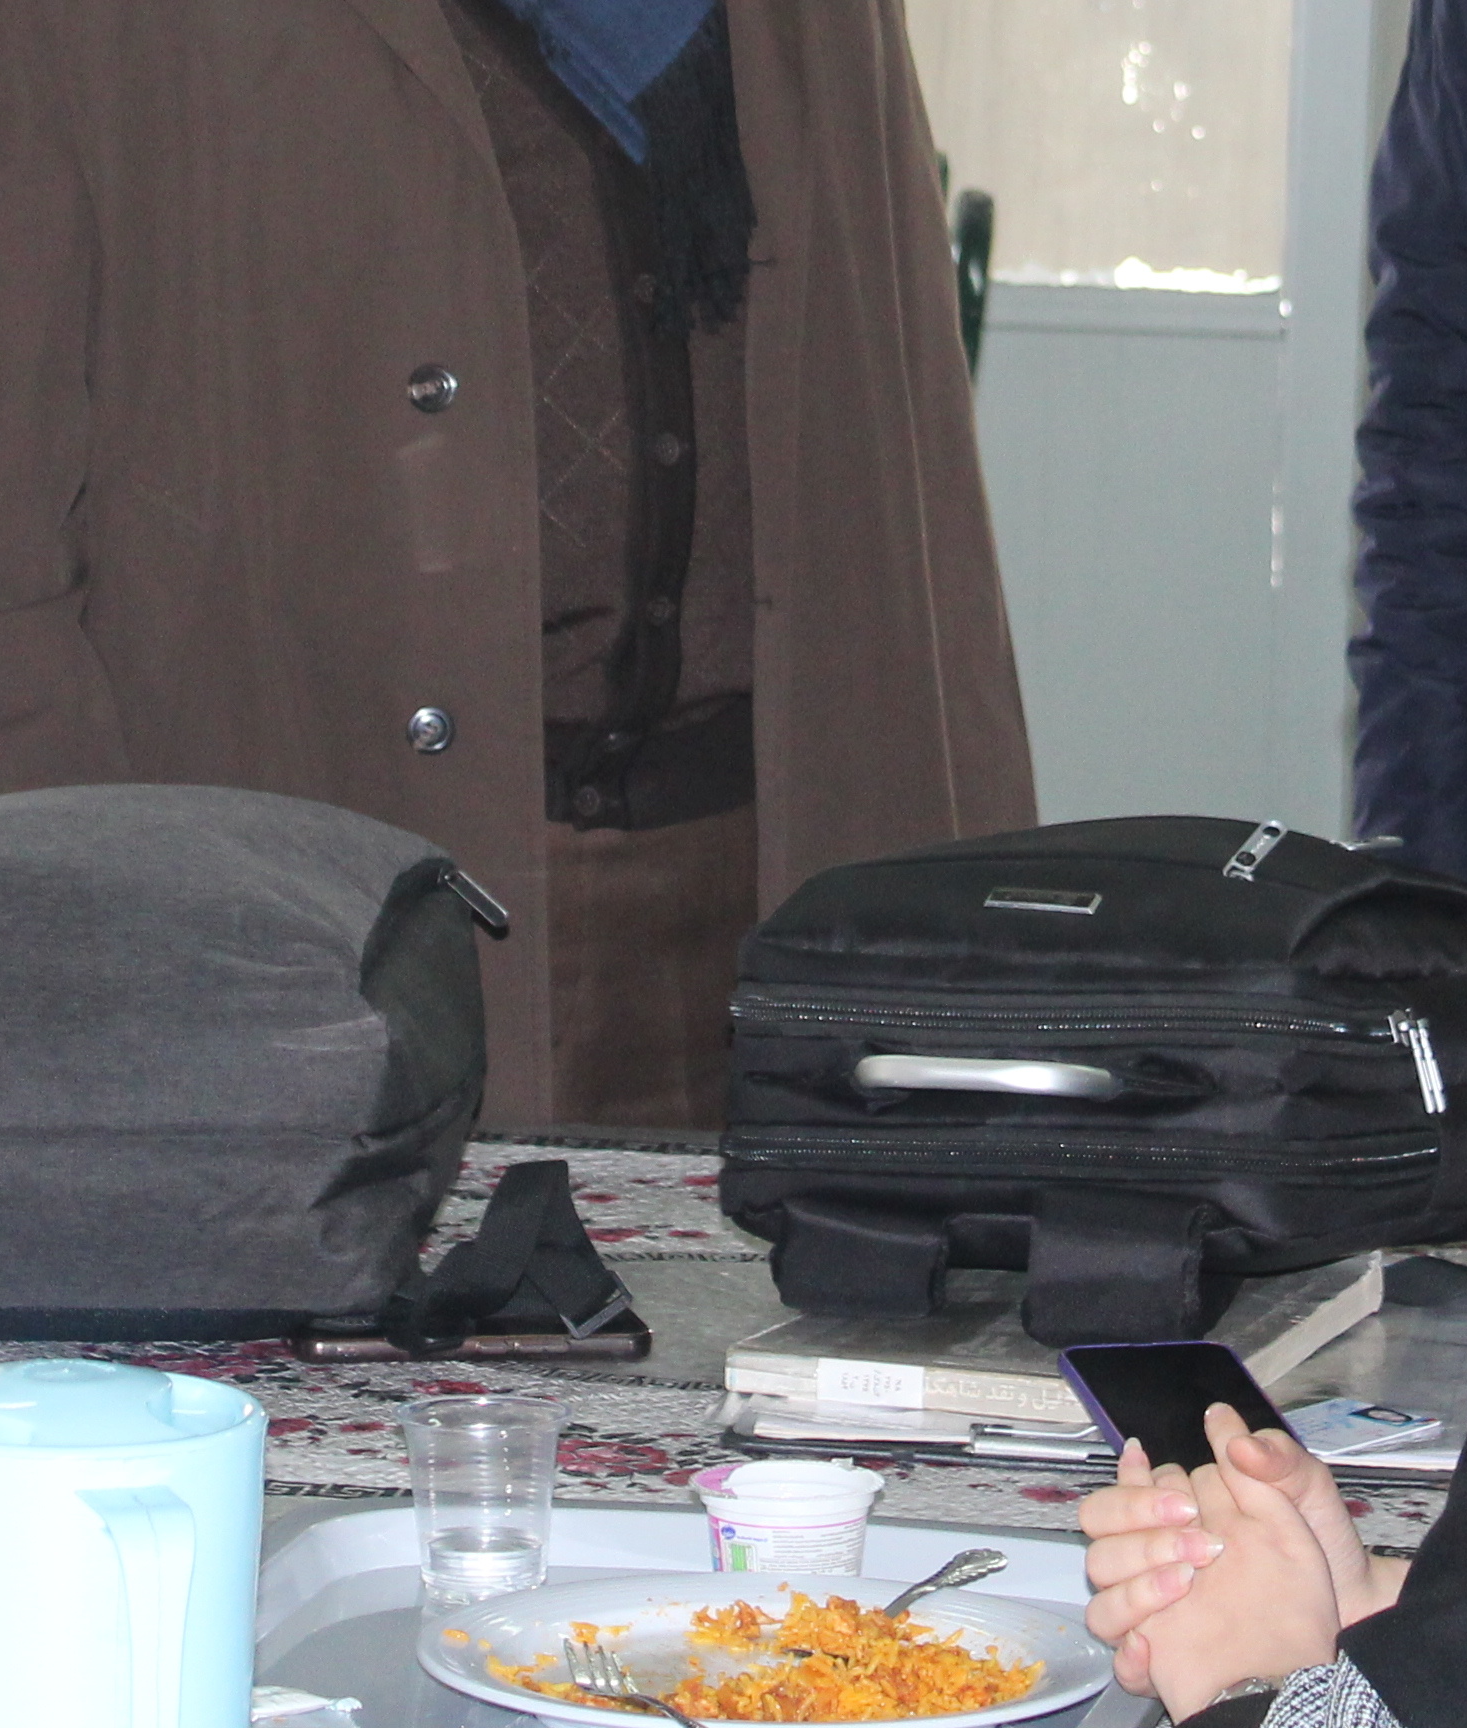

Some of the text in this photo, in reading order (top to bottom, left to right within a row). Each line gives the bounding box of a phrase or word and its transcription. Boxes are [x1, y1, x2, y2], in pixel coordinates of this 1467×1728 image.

[925, 1376, 981, 1398] شاهکا
[986, 1383, 1015, 1401] نقد
[1017, 1393, 1027, 1408] و
